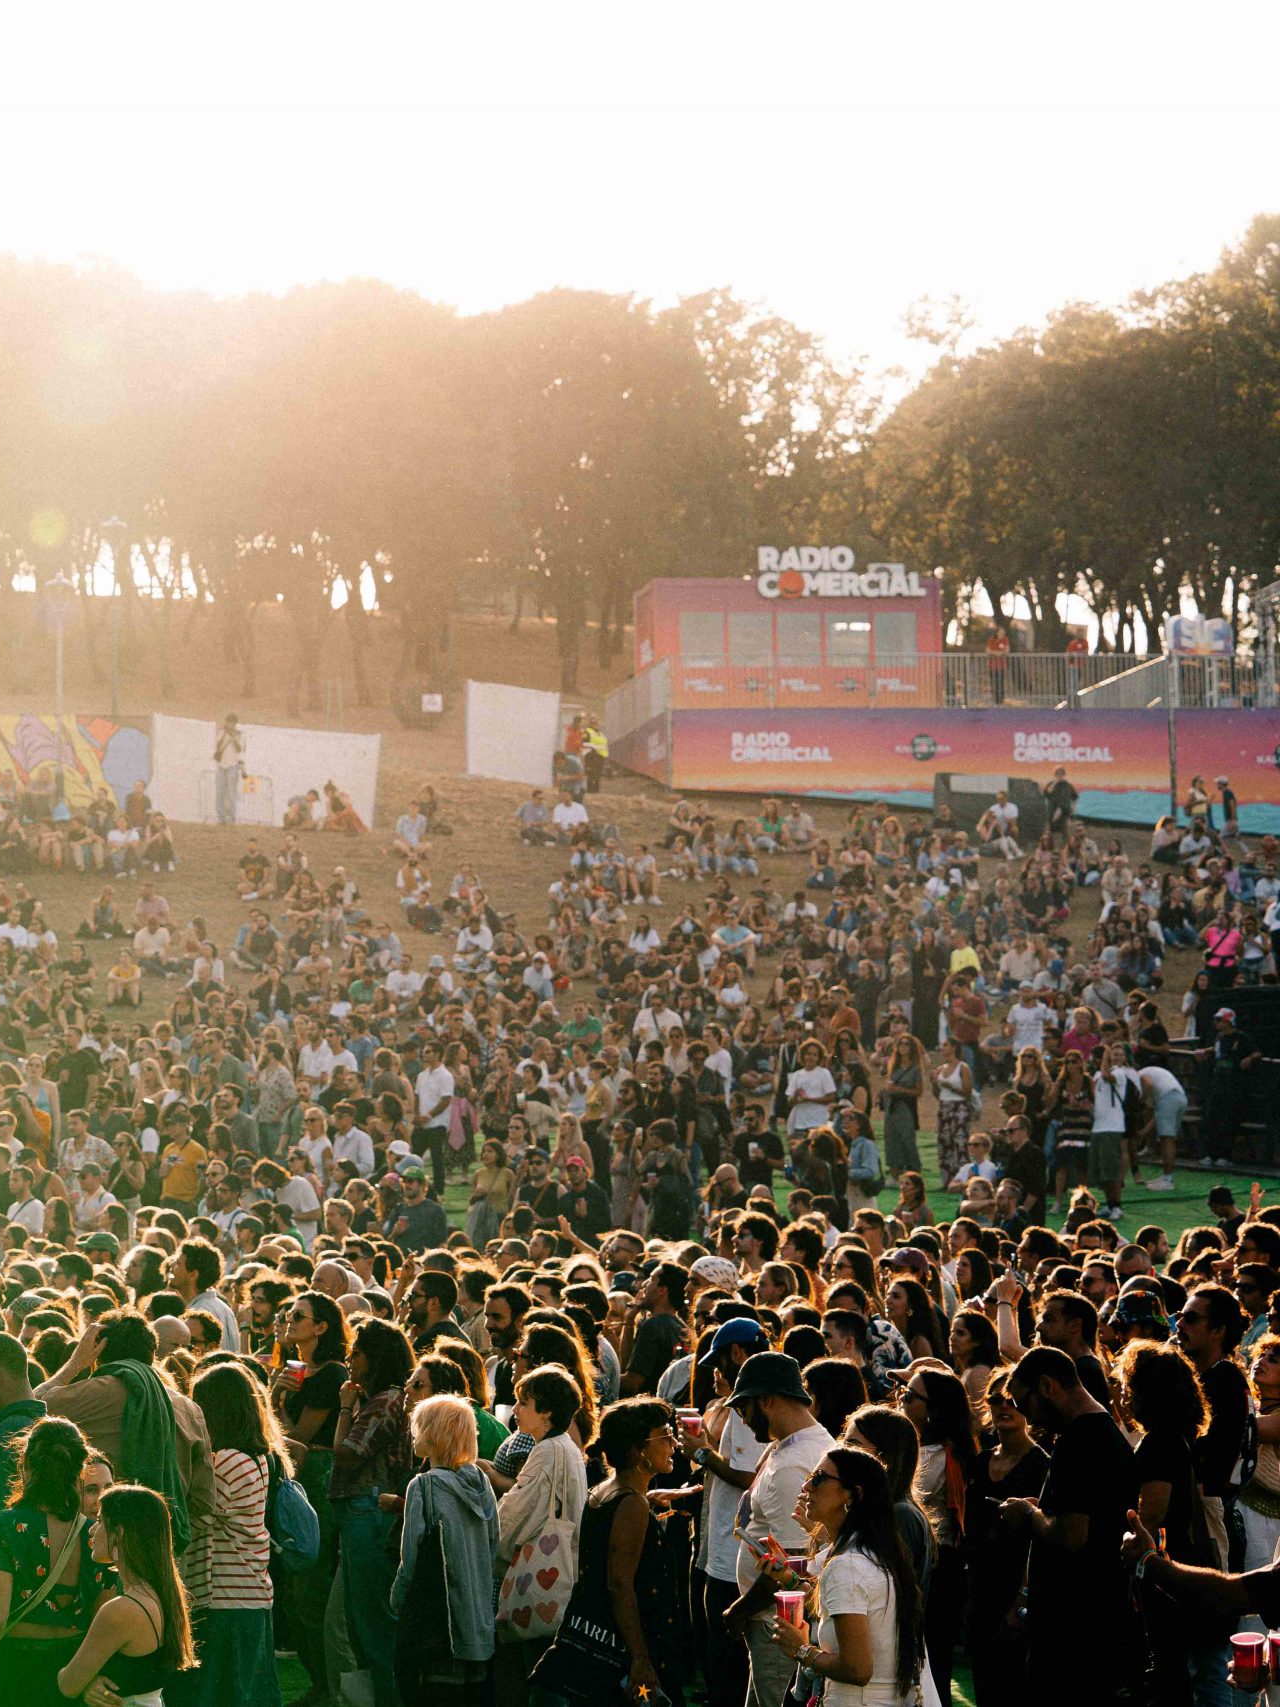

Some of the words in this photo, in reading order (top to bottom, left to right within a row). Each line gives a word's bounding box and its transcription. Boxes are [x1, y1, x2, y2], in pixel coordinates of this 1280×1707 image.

[758, 546, 855, 571] RADIO
[758, 571, 927, 599] COMERCIAL
[731, 732, 790, 747] RADIO
[1014, 732, 1072, 747] RADIO
[731, 746, 832, 762] COMERCIAL
